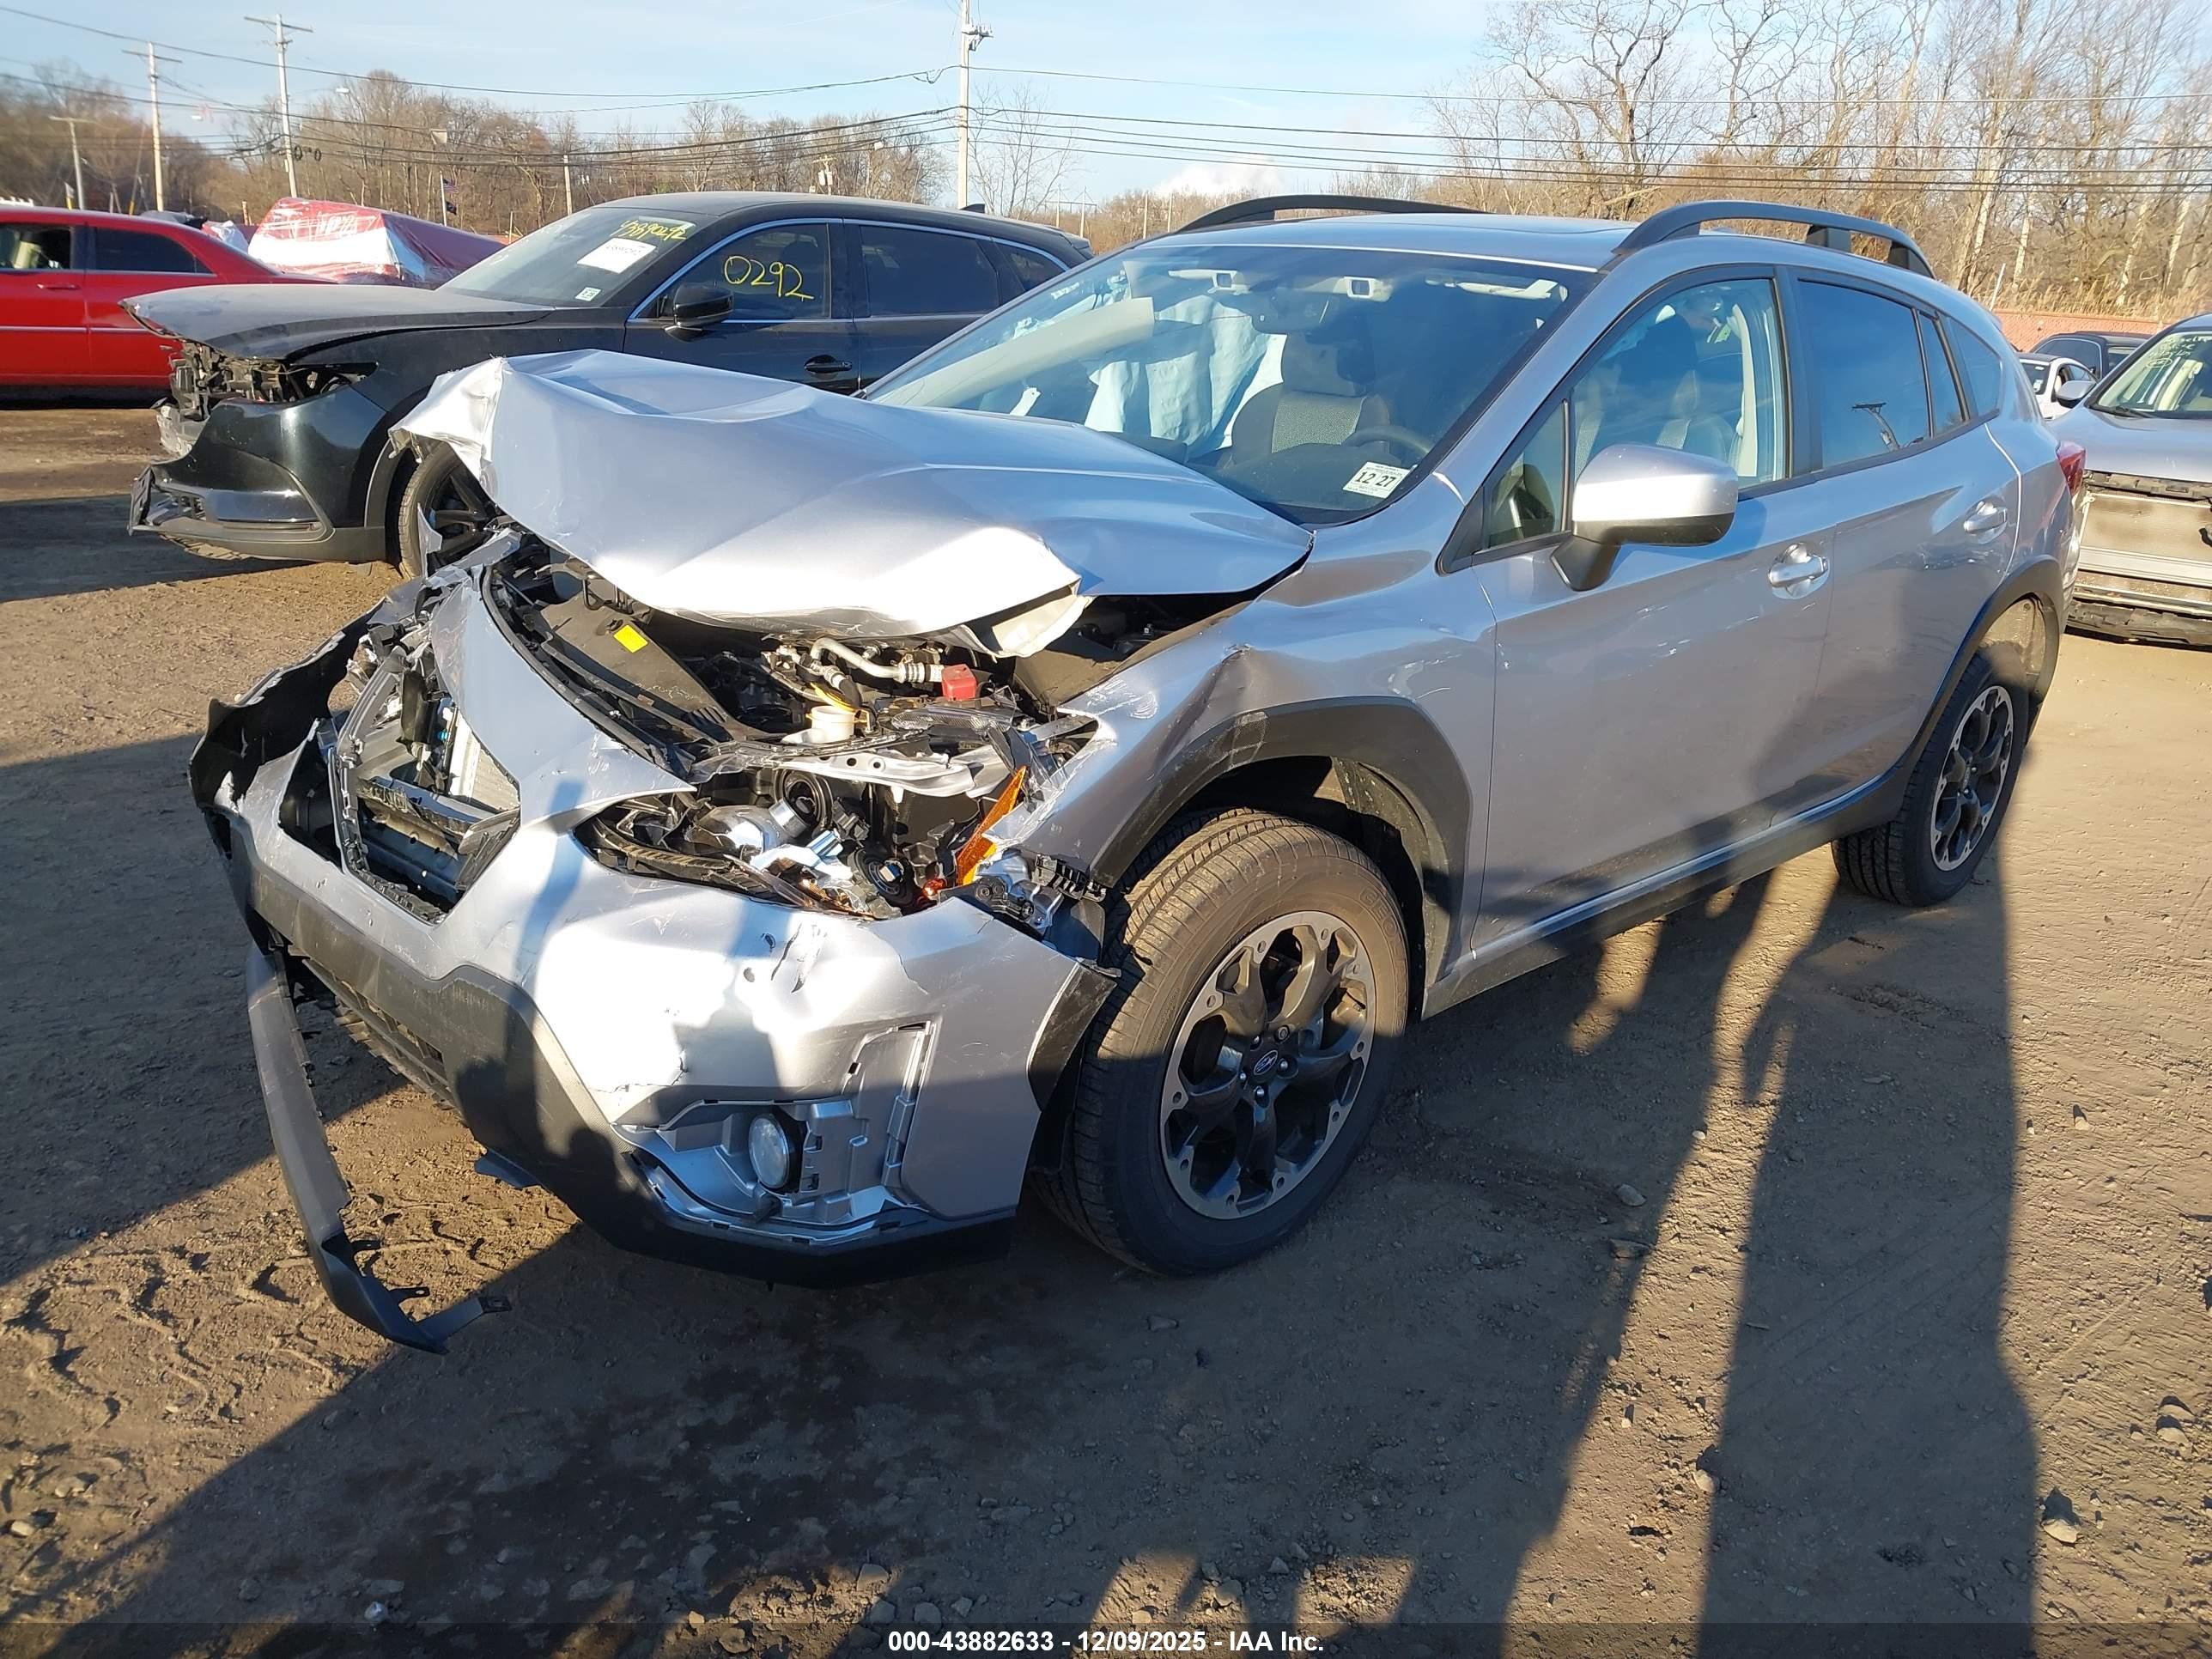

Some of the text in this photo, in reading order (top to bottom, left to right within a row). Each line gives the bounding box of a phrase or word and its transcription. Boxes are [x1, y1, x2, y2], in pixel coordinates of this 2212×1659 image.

[724, 255, 815, 301] 0292
[1355, 471, 1396, 487] 12 27
